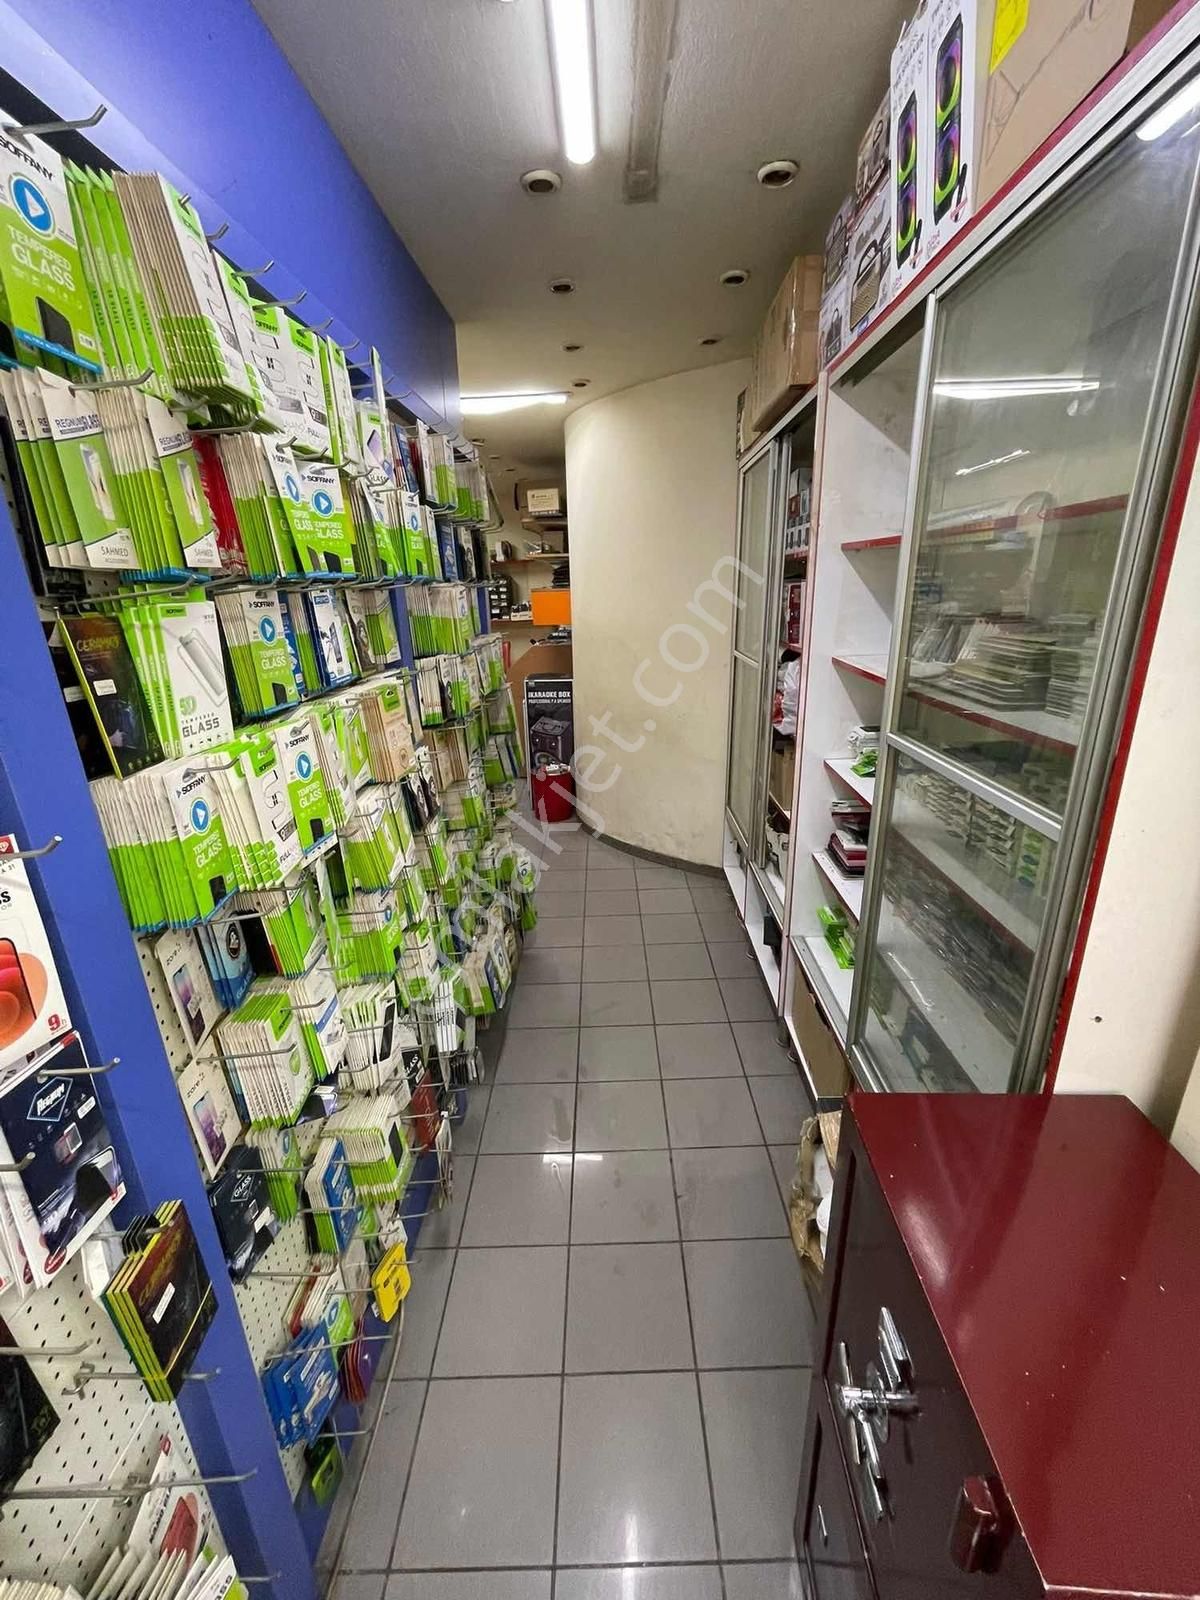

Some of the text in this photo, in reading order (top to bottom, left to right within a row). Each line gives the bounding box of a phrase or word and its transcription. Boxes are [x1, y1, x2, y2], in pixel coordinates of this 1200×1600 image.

[12, 242, 76, 291] GLASS
[306, 475, 336, 485] SOFFANY
[252, 600, 275, 609] SOFFANY
[261, 656, 287, 671] GLASS
[181, 712, 215, 725] TEMPERED
[182, 717, 221, 739] GLASS
[181, 774, 207, 796] SOFFANY
[299, 789, 323, 808] GLASS
[195, 838, 223, 869] GLASS
[233, 1174, 252, 1198] GLASS
